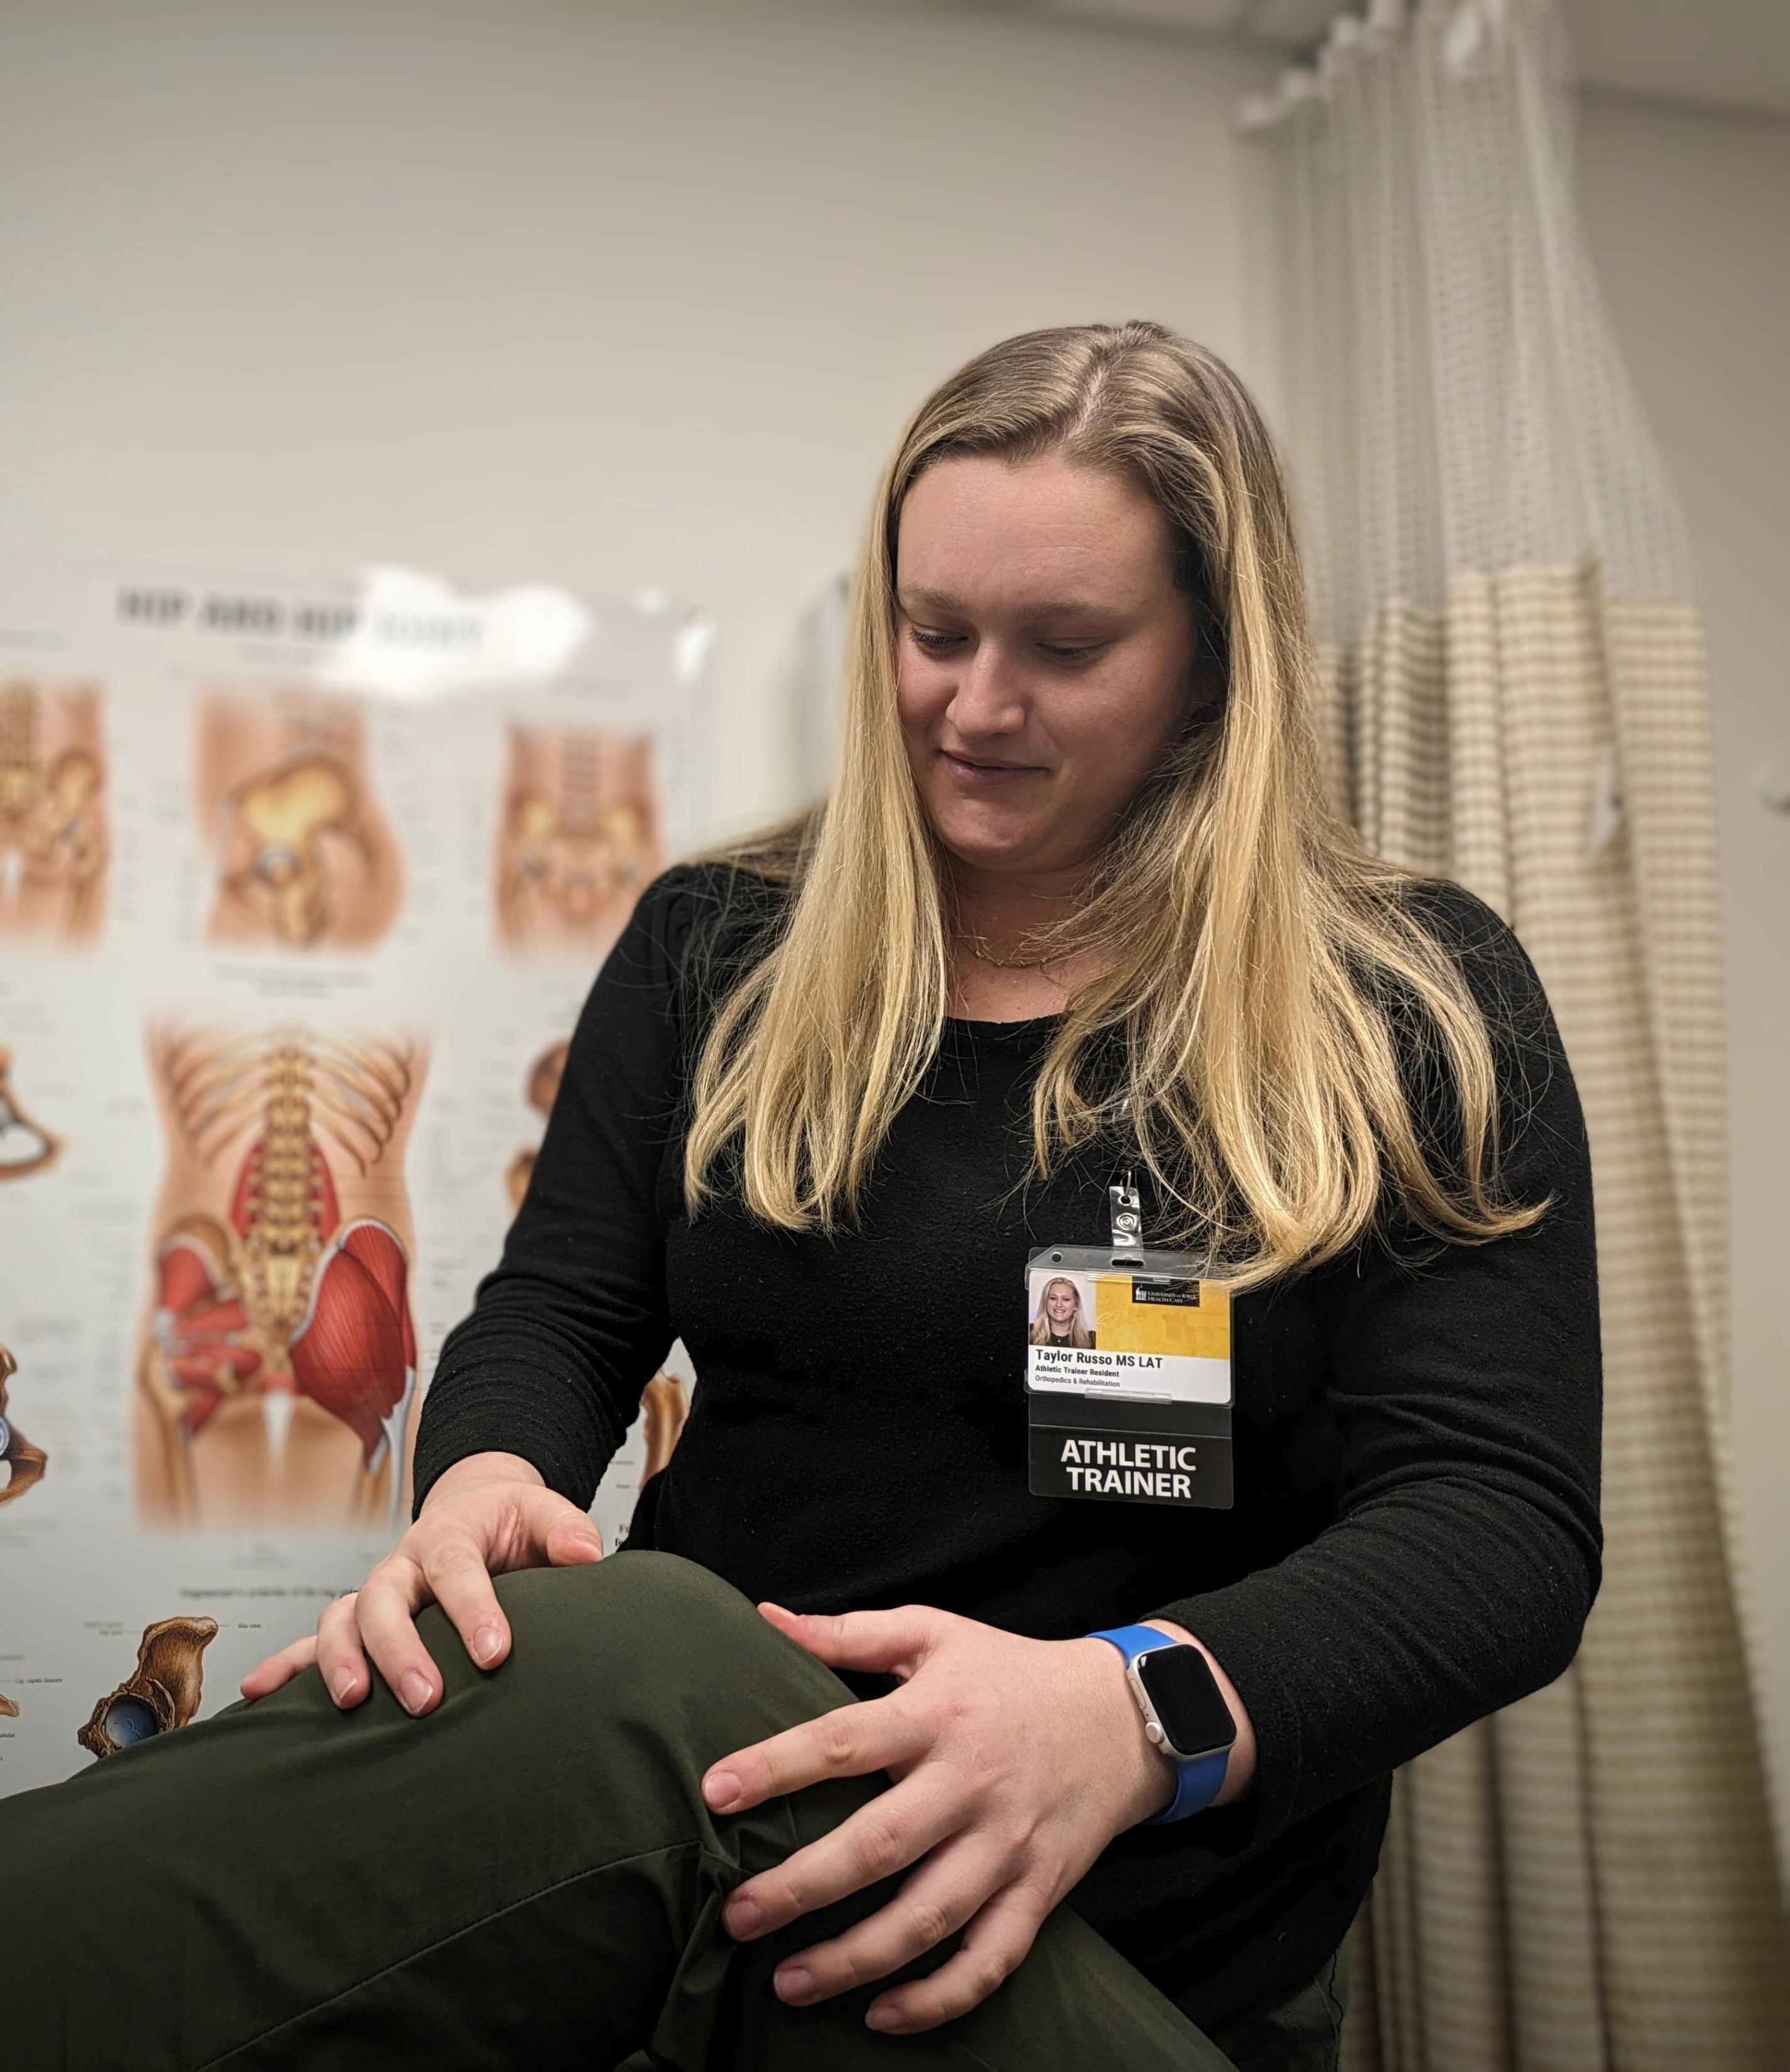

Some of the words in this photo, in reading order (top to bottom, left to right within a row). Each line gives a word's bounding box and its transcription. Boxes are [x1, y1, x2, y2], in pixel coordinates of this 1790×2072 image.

[1035, 1349, 1073, 1364] Taylor
[1077, 1352, 1112, 1365] Russo
[1116, 1355, 1135, 1366] MS
[1138, 1356, 1163, 1368] LAT
[1035, 1365, 1062, 1373] Athletic
[1064, 1366, 1088, 1375] Trainer
[1089, 1368, 1119, 1377] Resident
[1035, 1375, 1071, 1384] Orthopedics
[1079, 1378, 1120, 1387] Rehabilitation
[1060, 1439, 1197, 1471] ATHLETIC
[1066, 1466, 1192, 1499] TRAINER
